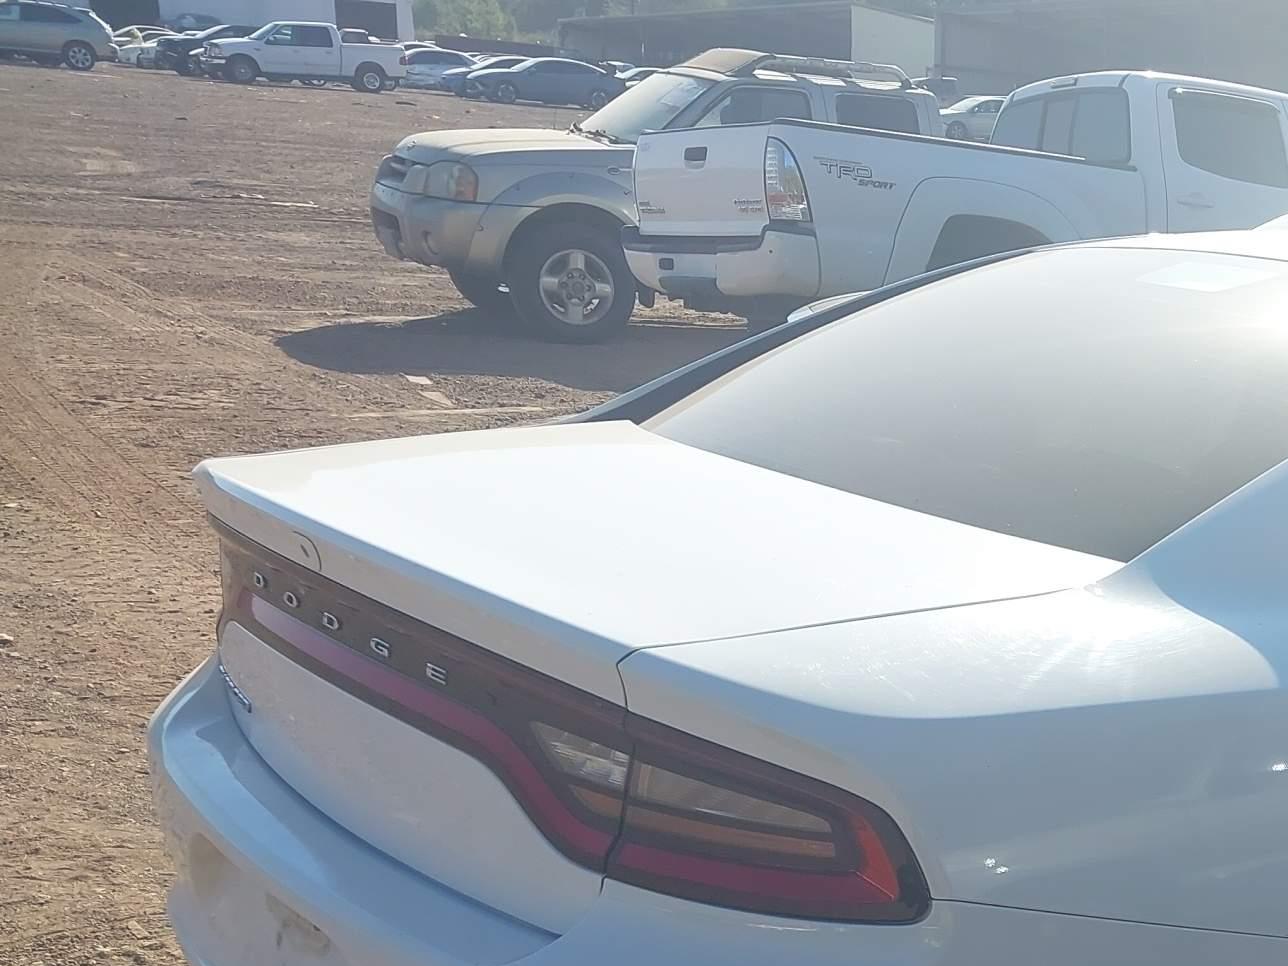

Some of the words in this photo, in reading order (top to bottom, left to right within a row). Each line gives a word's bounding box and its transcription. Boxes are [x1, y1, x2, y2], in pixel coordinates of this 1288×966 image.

[819, 160, 873, 180] TRD
[857, 179, 896, 190] SPORT
[254, 571, 447, 686] DODGE
